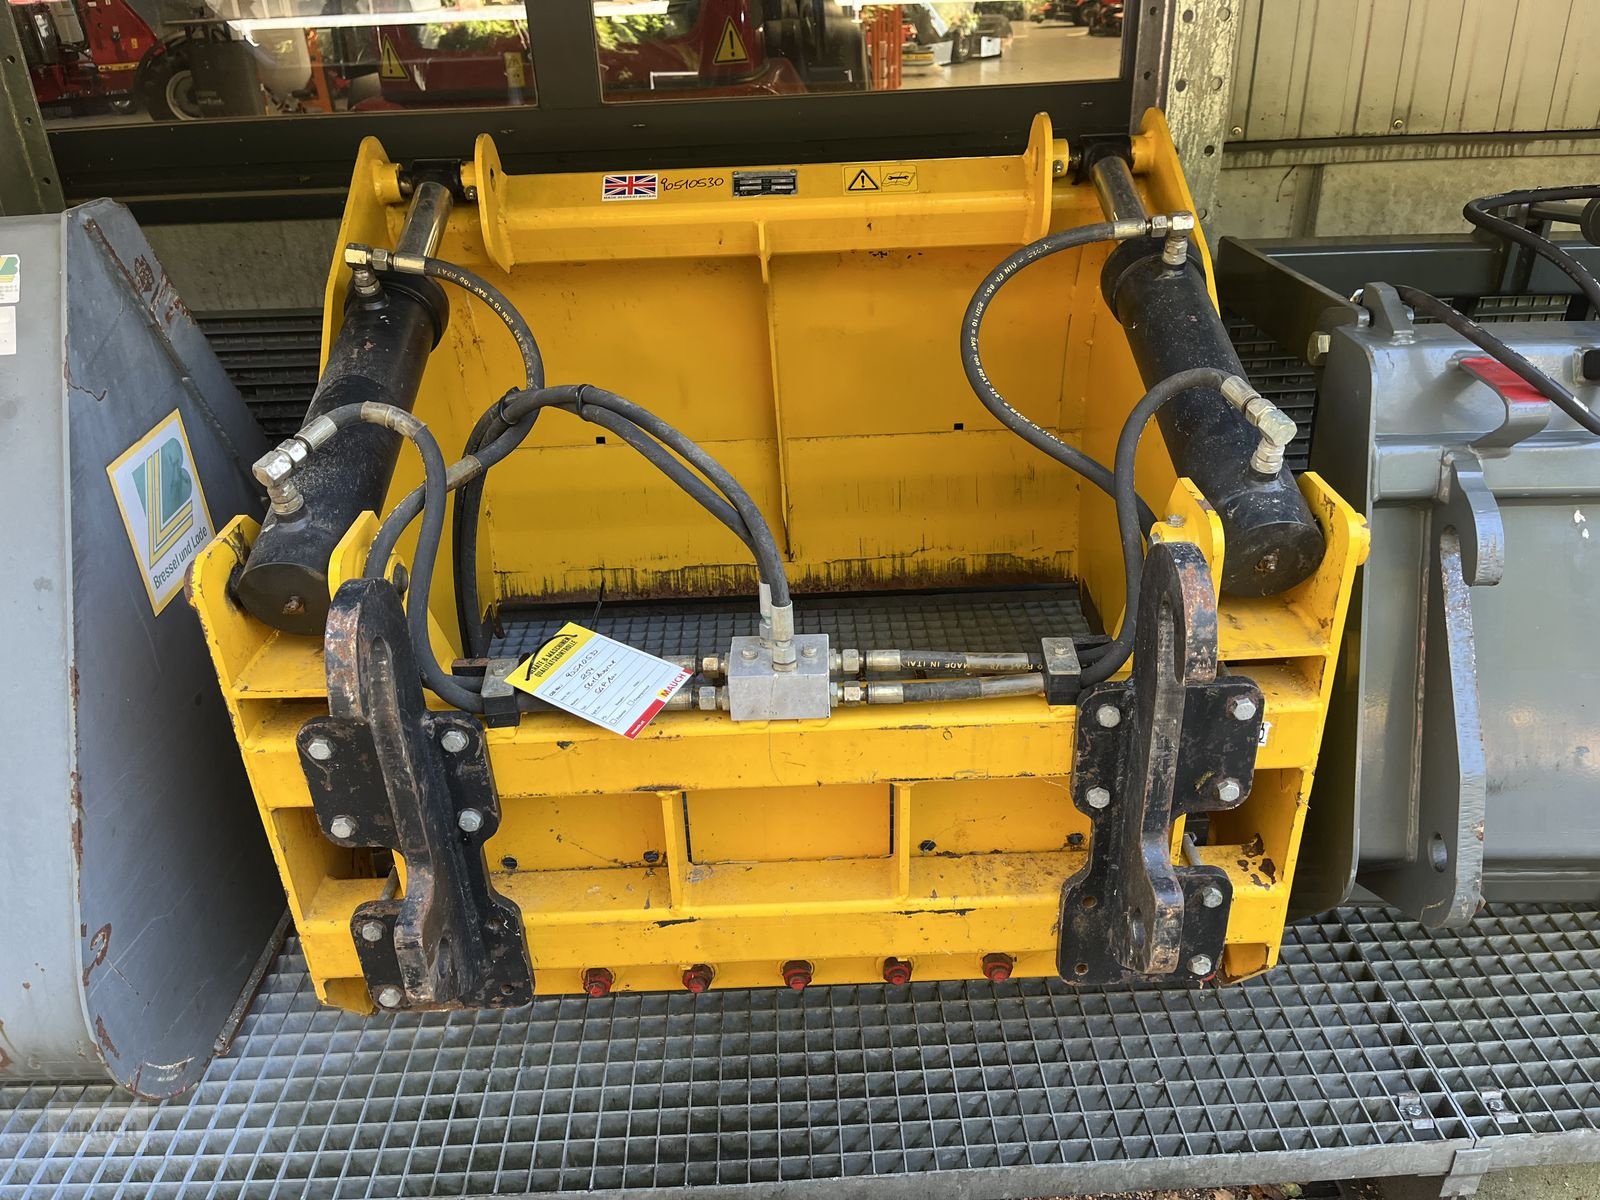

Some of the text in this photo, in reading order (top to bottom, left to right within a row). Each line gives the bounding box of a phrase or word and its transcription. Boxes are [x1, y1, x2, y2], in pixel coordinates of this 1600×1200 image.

[660, 177, 725, 191] 90510530
[152, 524, 208, 590] Bressel und Lade
[534, 640, 578, 678] QUALITÄTSKONTROLLE
[547, 637, 570, 658] MASCHINEN
[662, 673, 686, 697] MAUCH
